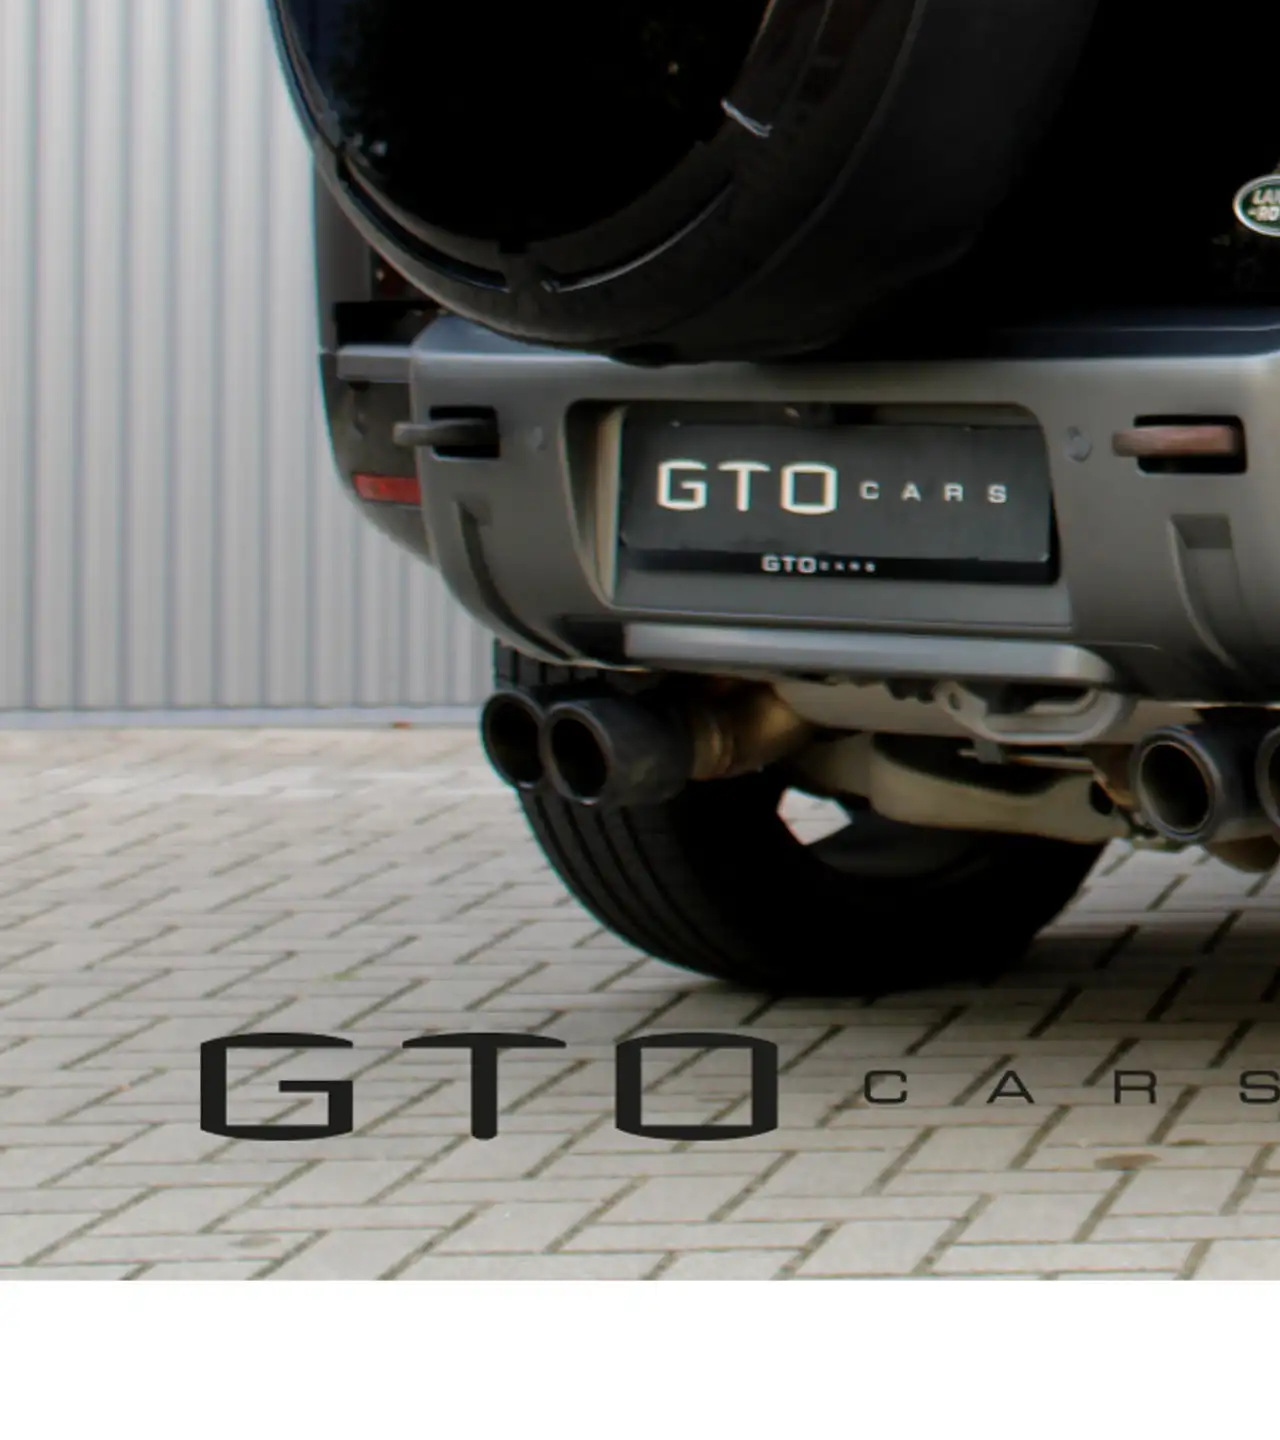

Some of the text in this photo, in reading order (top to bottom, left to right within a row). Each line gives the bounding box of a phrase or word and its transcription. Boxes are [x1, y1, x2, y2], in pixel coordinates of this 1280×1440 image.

[657, 459, 1008, 515] GTO CARS
[761, 554, 817, 574] GTO
